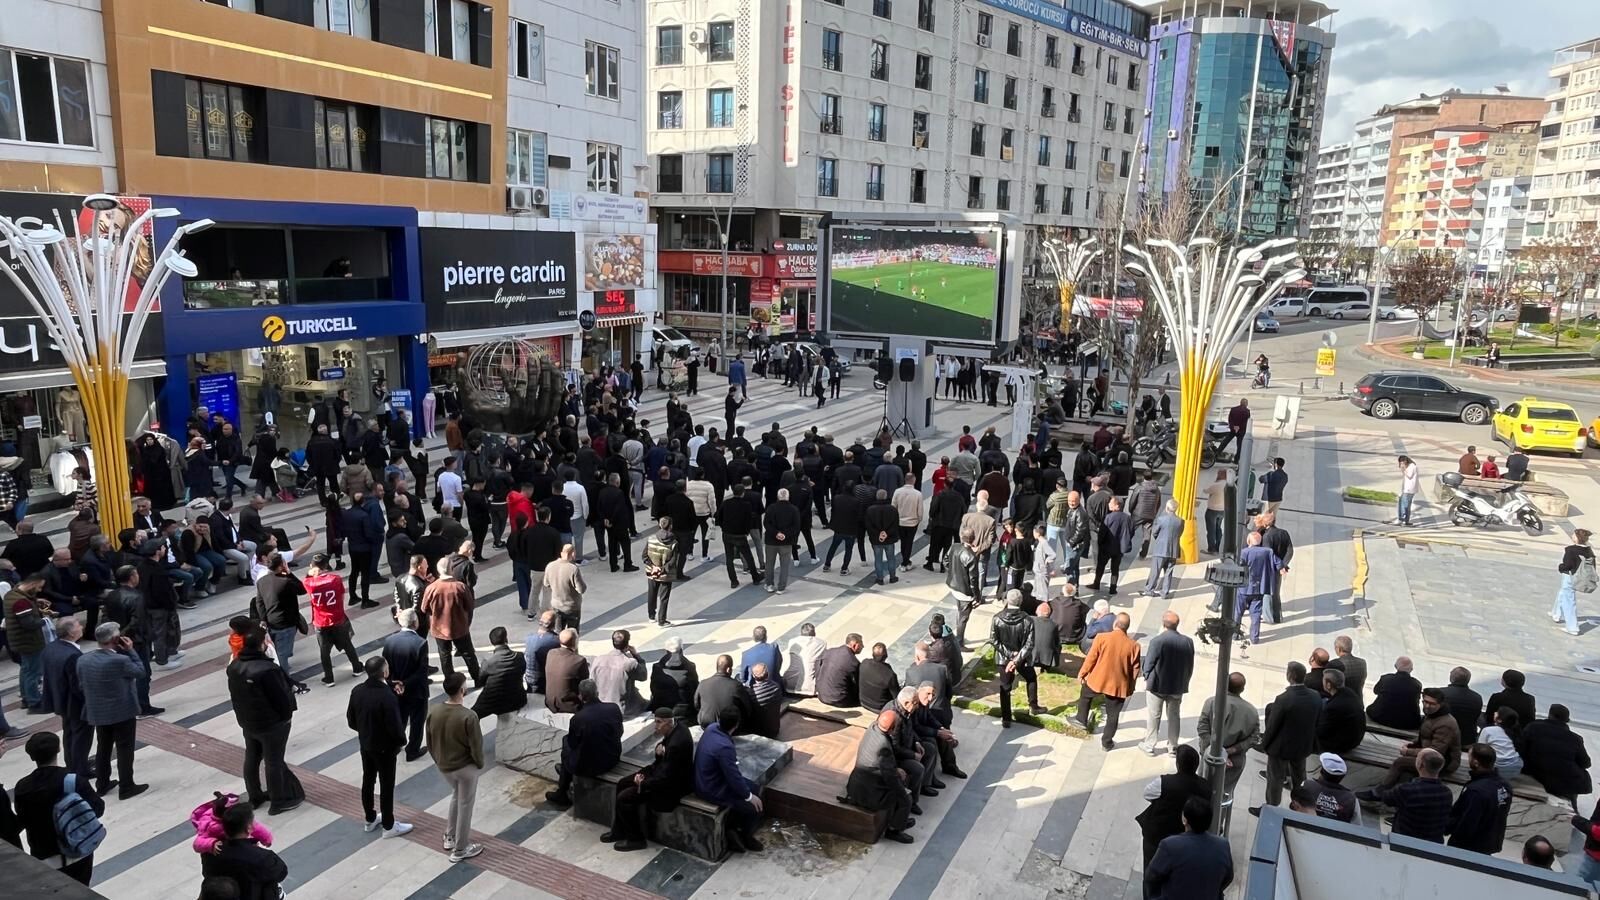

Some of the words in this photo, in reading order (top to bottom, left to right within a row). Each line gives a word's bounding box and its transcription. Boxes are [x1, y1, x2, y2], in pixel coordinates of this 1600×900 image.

[1040, 6, 1065, 24] KURSU
[1310, 60, 1327, 153] YILMAZLAR
[705, 256, 748, 266] HACBABA
[443, 260, 505, 292] pierre
[510, 260, 566, 284] cardin
[494, 287, 526, 309] lingerie
[548, 287, 566, 296] PARIS
[606, 290, 625, 305] SEÇ
[286, 317, 357, 335] TURKCELL
[311, 590, 337, 607] 72
